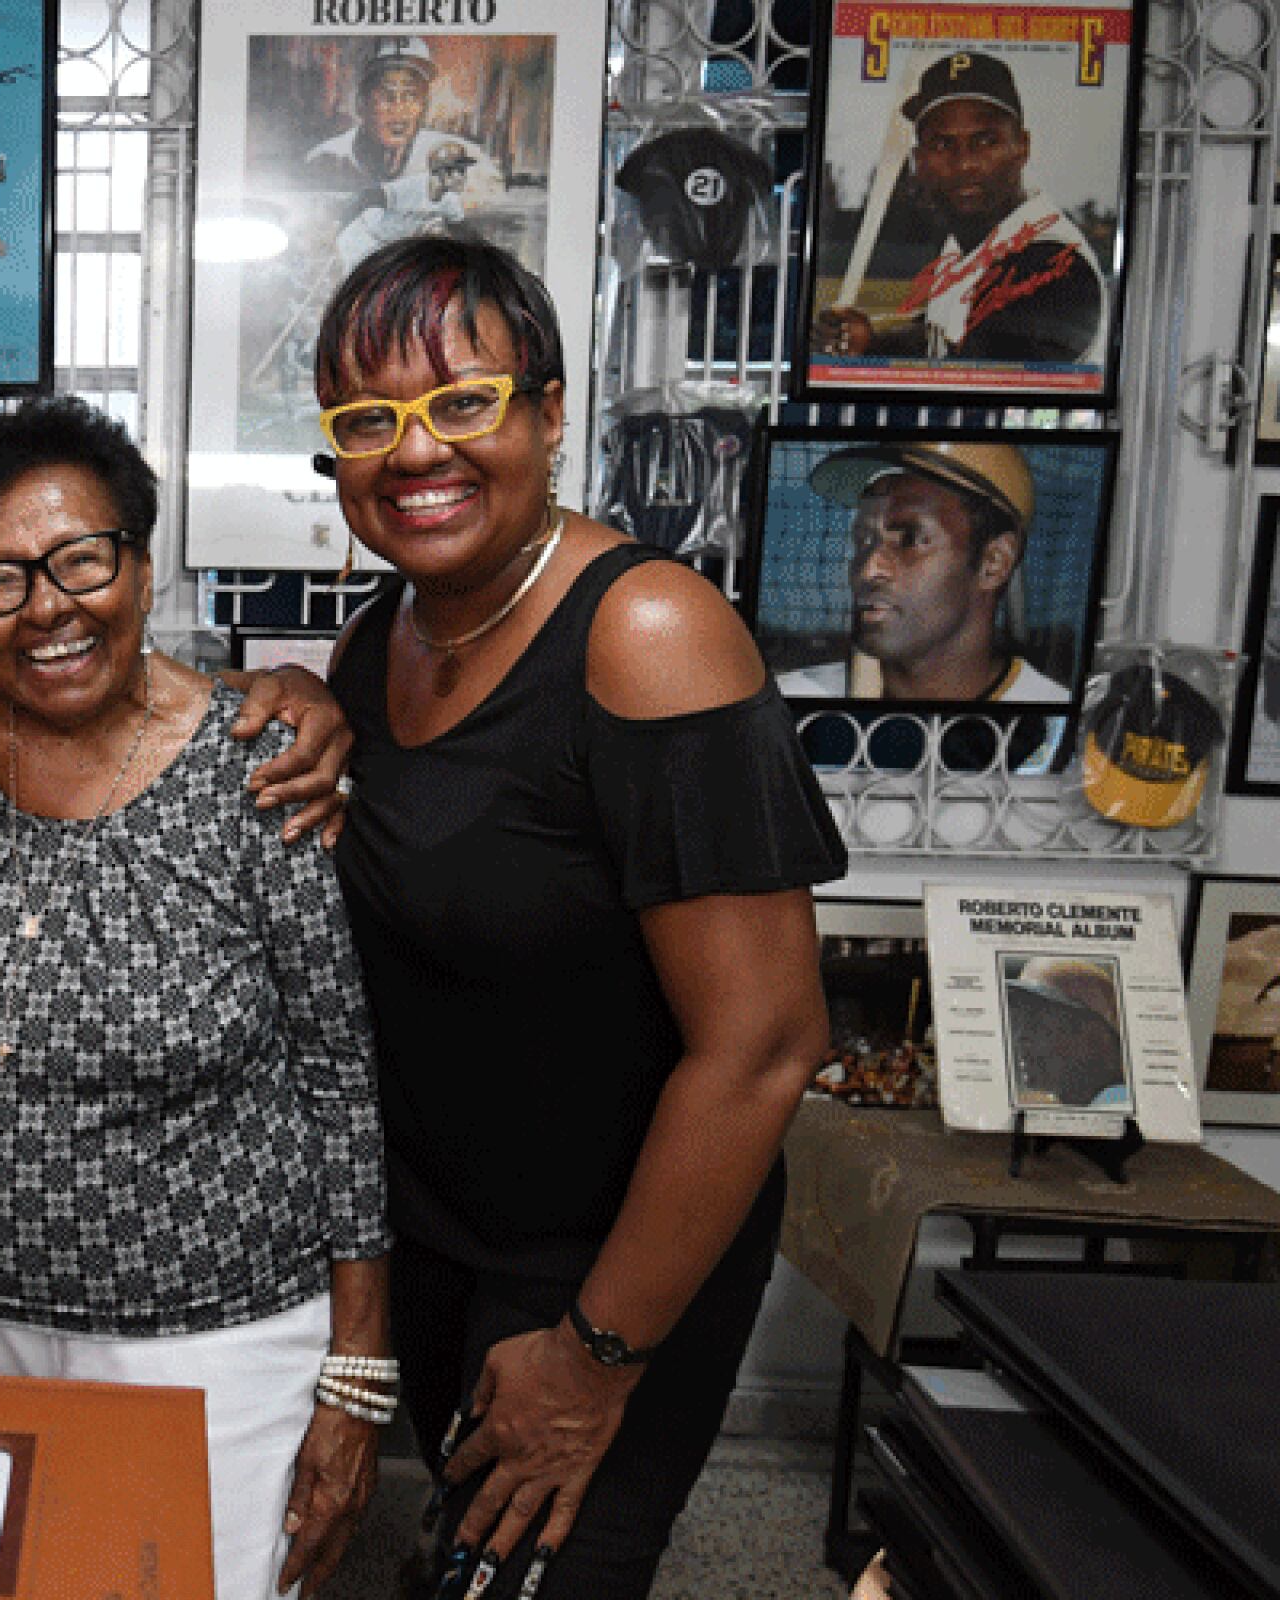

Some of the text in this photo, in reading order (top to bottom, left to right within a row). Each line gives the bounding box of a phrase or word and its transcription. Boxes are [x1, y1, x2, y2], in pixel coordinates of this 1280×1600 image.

[312, 0, 498, 25] ROBERTO
[691, 175, 721, 199] 21
[959, 899, 1142, 923] ROBERTO CLEMENTE
[969, 918, 1136, 941] MEMORIAL ALBUM
